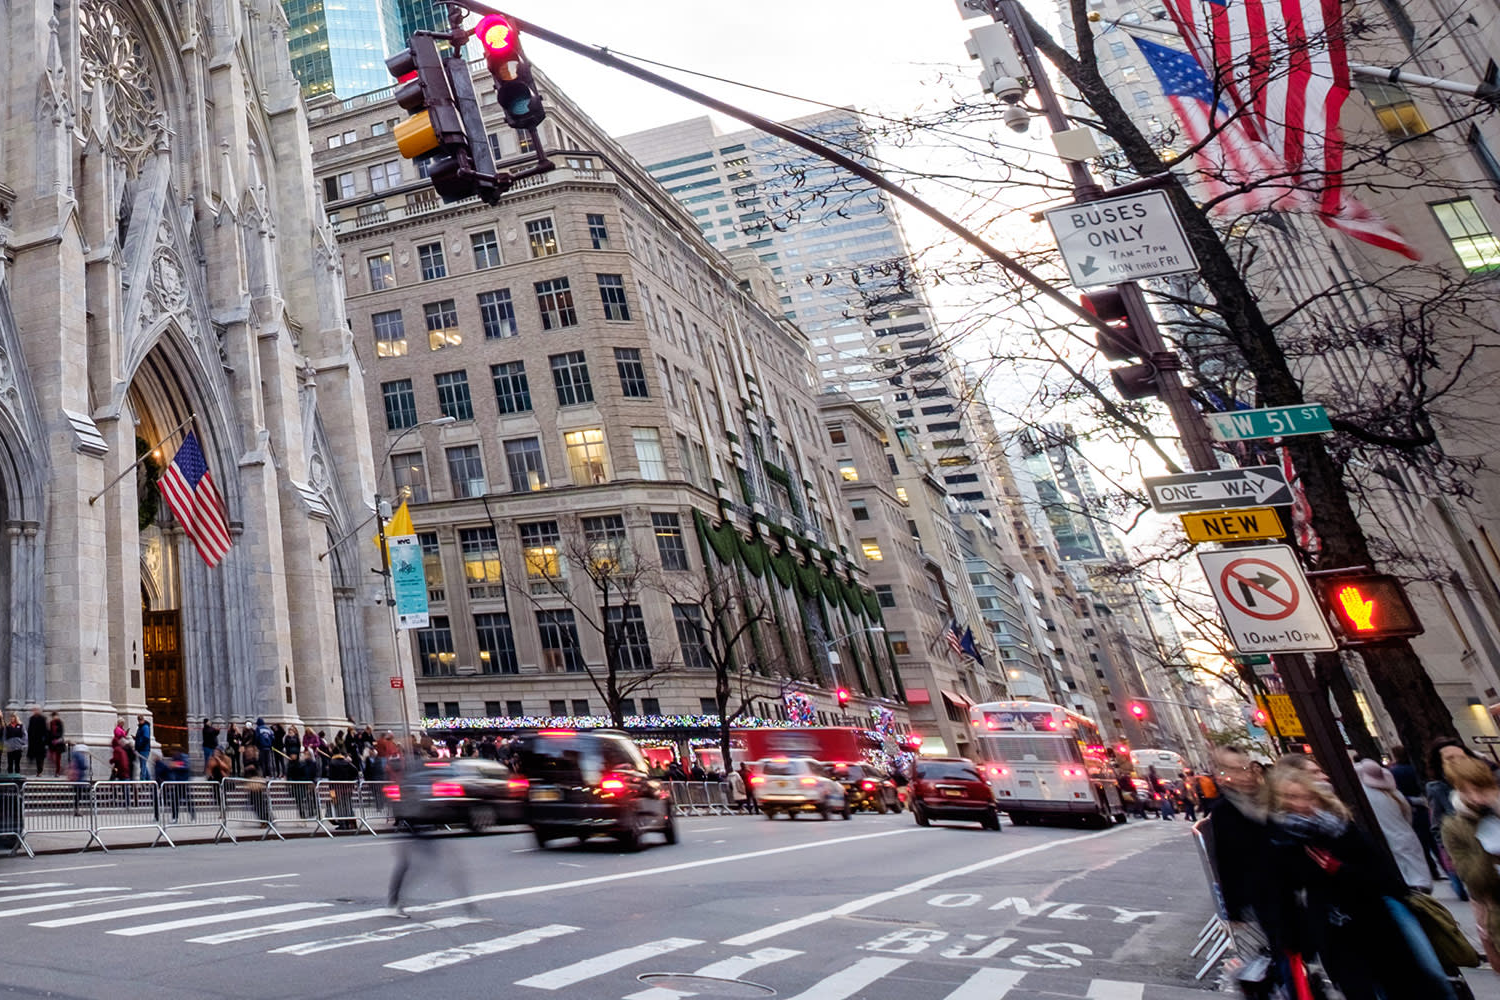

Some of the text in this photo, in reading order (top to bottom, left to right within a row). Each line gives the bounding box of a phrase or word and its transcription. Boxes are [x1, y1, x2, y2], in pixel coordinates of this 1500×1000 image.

[1071, 203, 1147, 229] BUSES
[1088, 224, 1143, 247] ONLY
[1108, 255, 1180, 275] MON THRU FRI
[1232, 408, 1319, 436] W 51 ST
[1161, 479, 1265, 501] ONE WAY
[1202, 515, 1259, 536] NEW
[926, 893, 1169, 924] ONLY
[855, 927, 1094, 969] BUS
